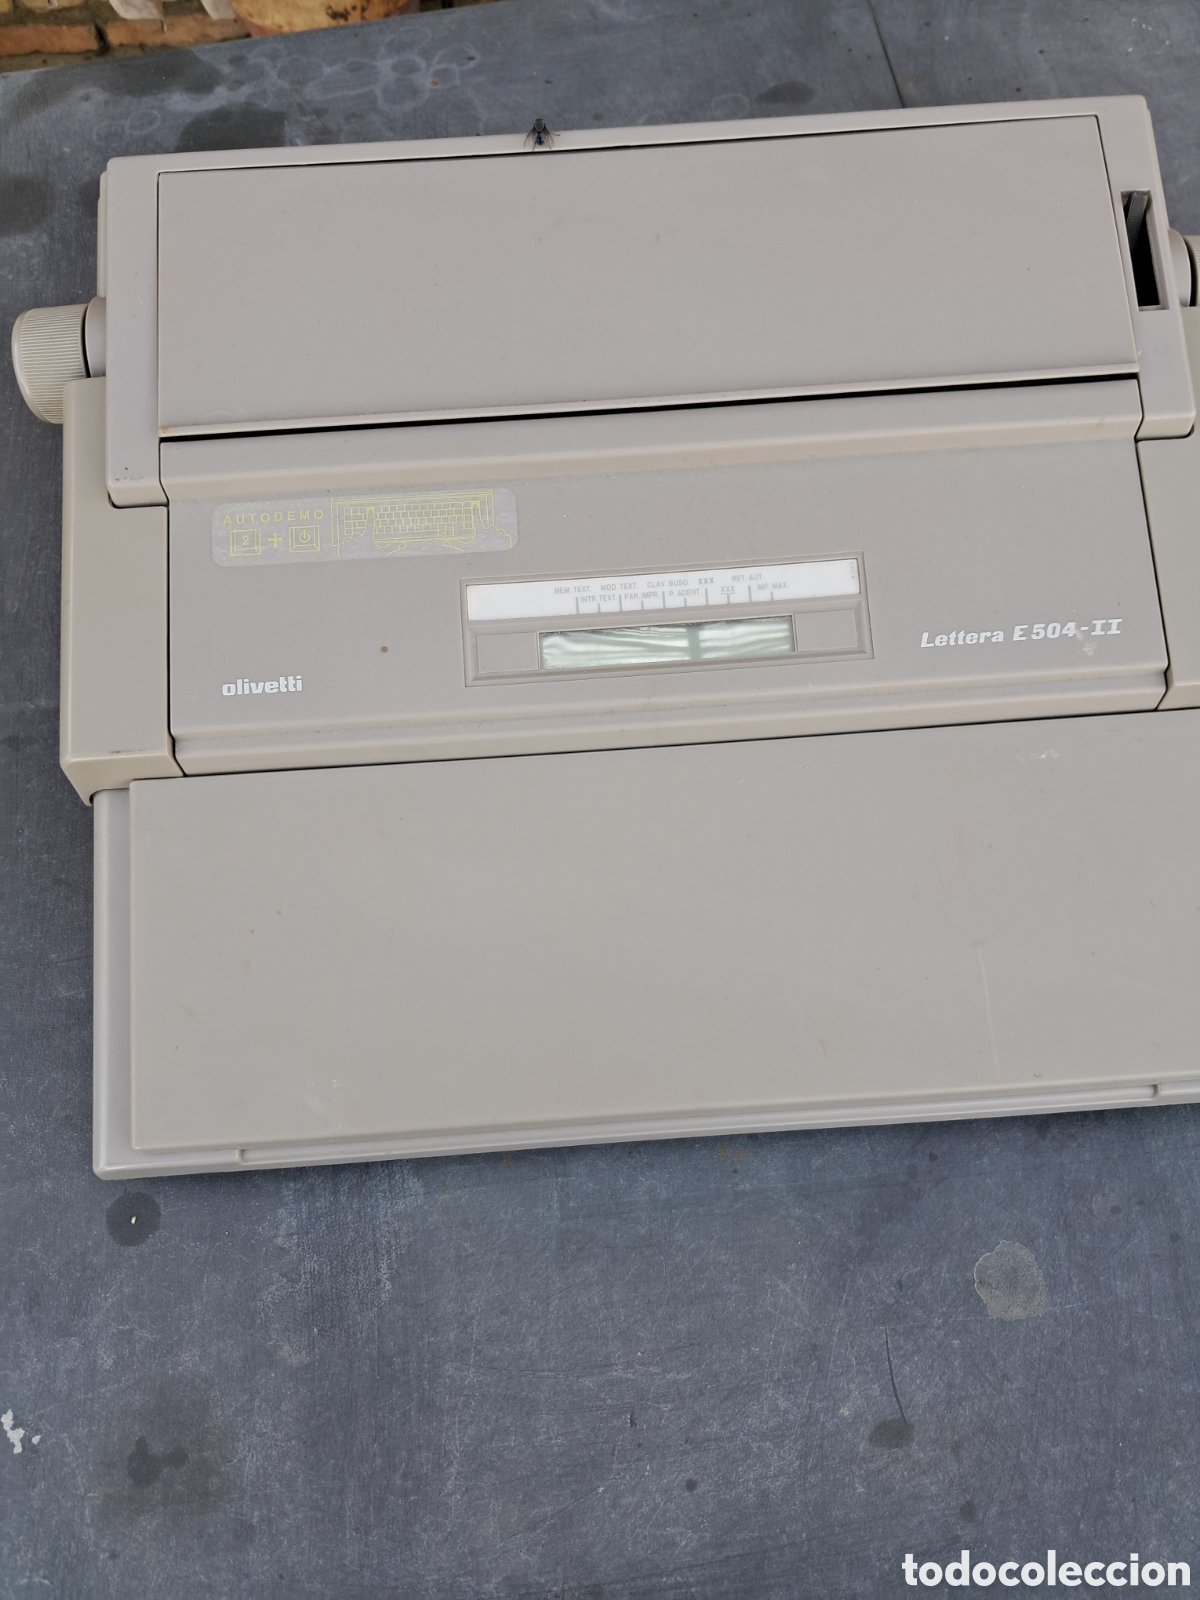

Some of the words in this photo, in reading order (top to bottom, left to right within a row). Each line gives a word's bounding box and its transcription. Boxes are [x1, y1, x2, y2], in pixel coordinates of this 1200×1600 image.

[223, 509, 324, 526] AUTODEMO
[698, 577, 715, 585] XXX
[732, 574, 747, 582] RET.
[749, 573, 765, 581] AUT.
[647, 580, 667, 588] CLAV.
[756, 583, 771, 591] IMP.
[554, 586, 571, 594] MEM.
[580, 595, 599, 603] INTR.
[624, 592, 640, 600] PAR.
[641, 591, 660, 599] IMPR.
[920, 629, 1004, 648] Lettera
[222, 675, 303, 696] olivetti
